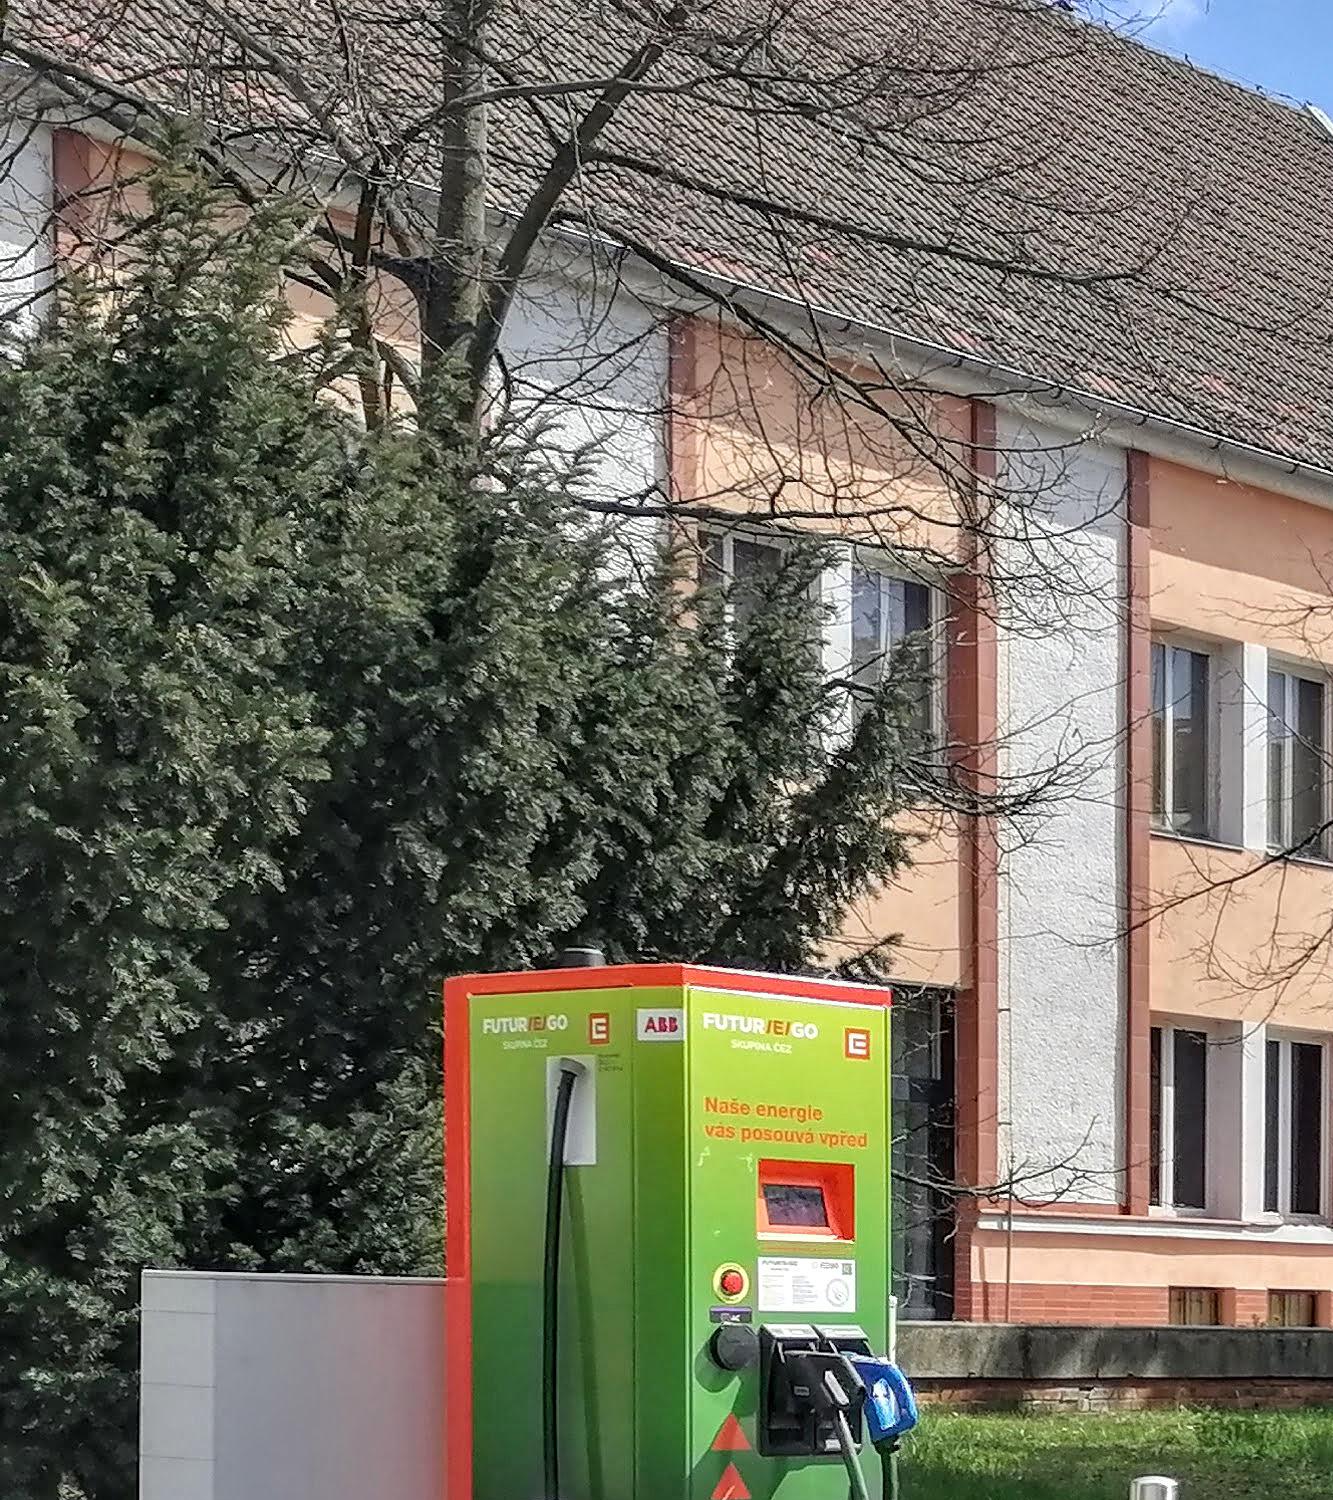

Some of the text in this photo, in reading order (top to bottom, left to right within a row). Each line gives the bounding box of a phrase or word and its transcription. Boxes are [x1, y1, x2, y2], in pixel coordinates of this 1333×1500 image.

[644, 1016, 679, 1033] ABB
[704, 1097, 823, 1123] Naše energie
[705, 1122, 868, 1148] vás posouvá vpřed
